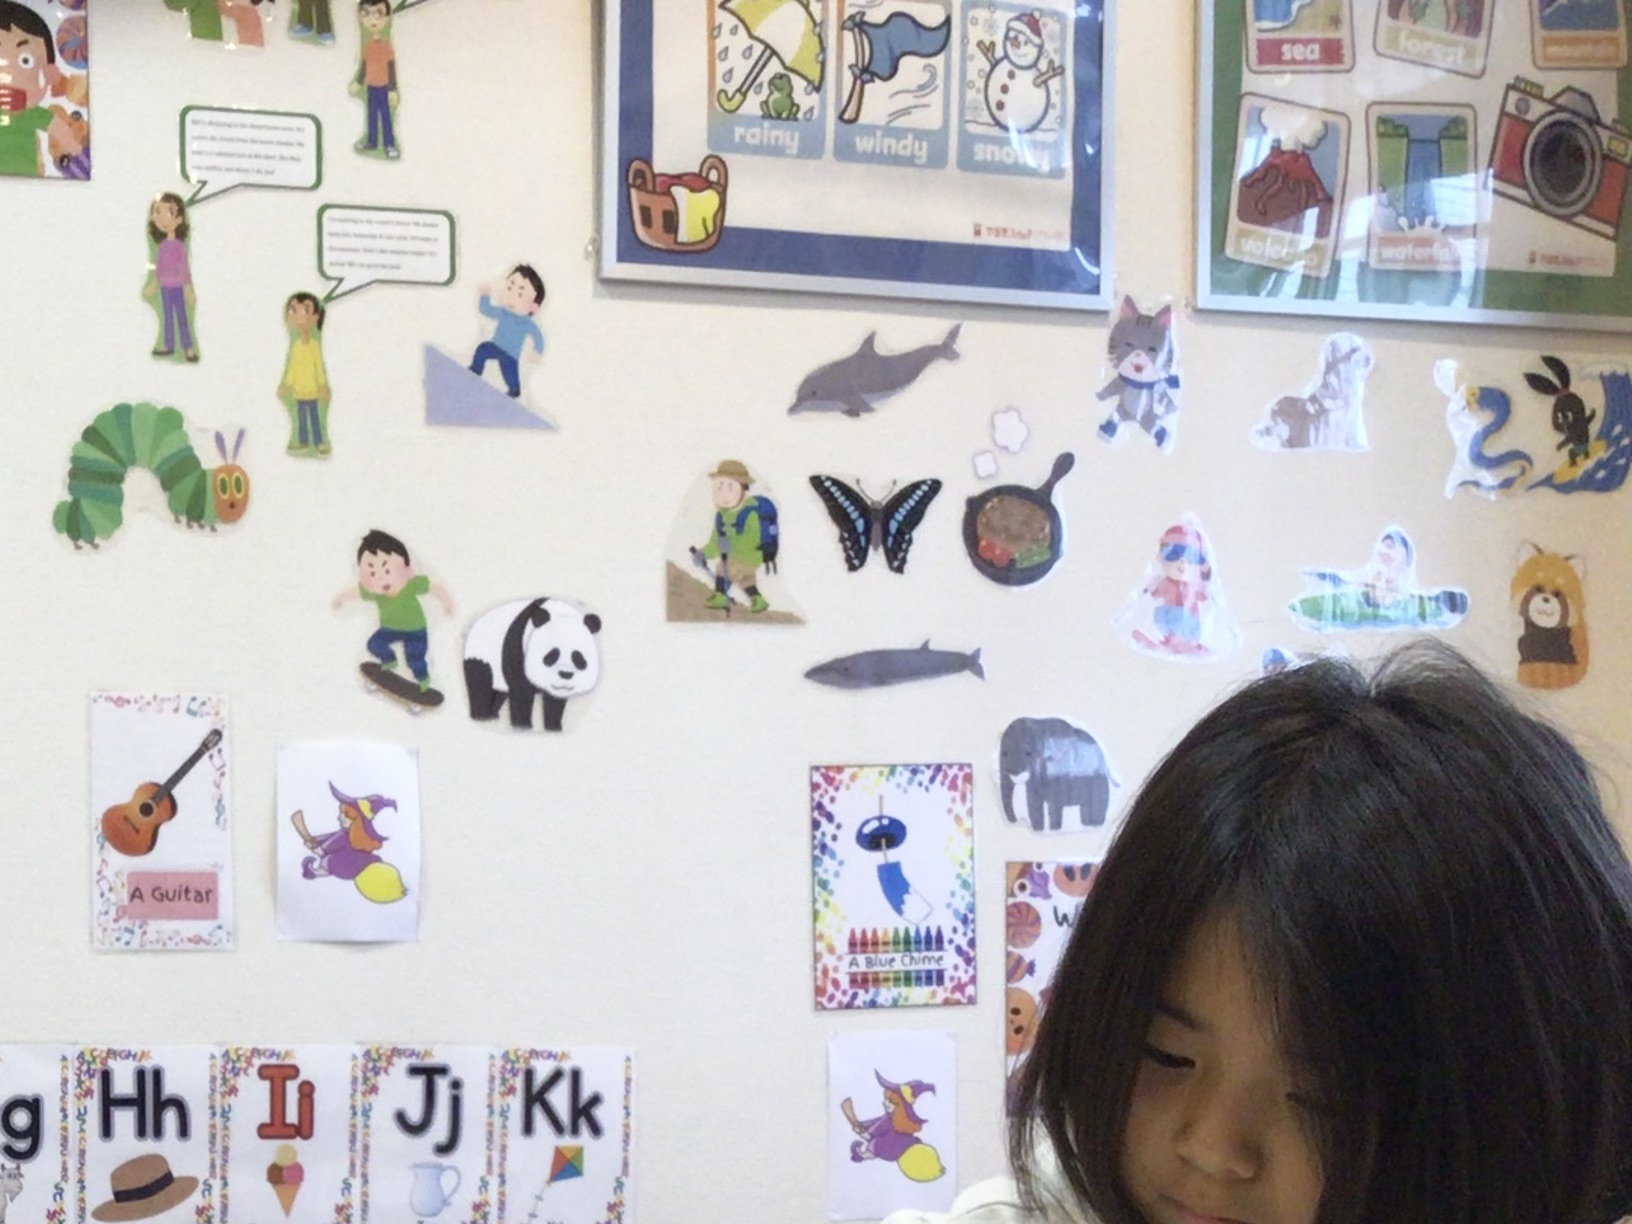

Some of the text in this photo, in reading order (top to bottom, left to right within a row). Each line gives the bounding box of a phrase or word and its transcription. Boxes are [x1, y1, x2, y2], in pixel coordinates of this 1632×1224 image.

[1280, 40, 1321, 62] sea
[733, 119, 800, 154] rainy
[854, 132, 929, 165] windy
[129, 885, 214, 904] A Guitar
[848, 956, 860, 971] A
[900, 952, 945, 968] Chime
[98, 1064, 192, 1144] Hh
[256, 1063, 316, 1141] Ii
[394, 1063, 464, 1158] Jj
[520, 1064, 605, 1140] Kk
